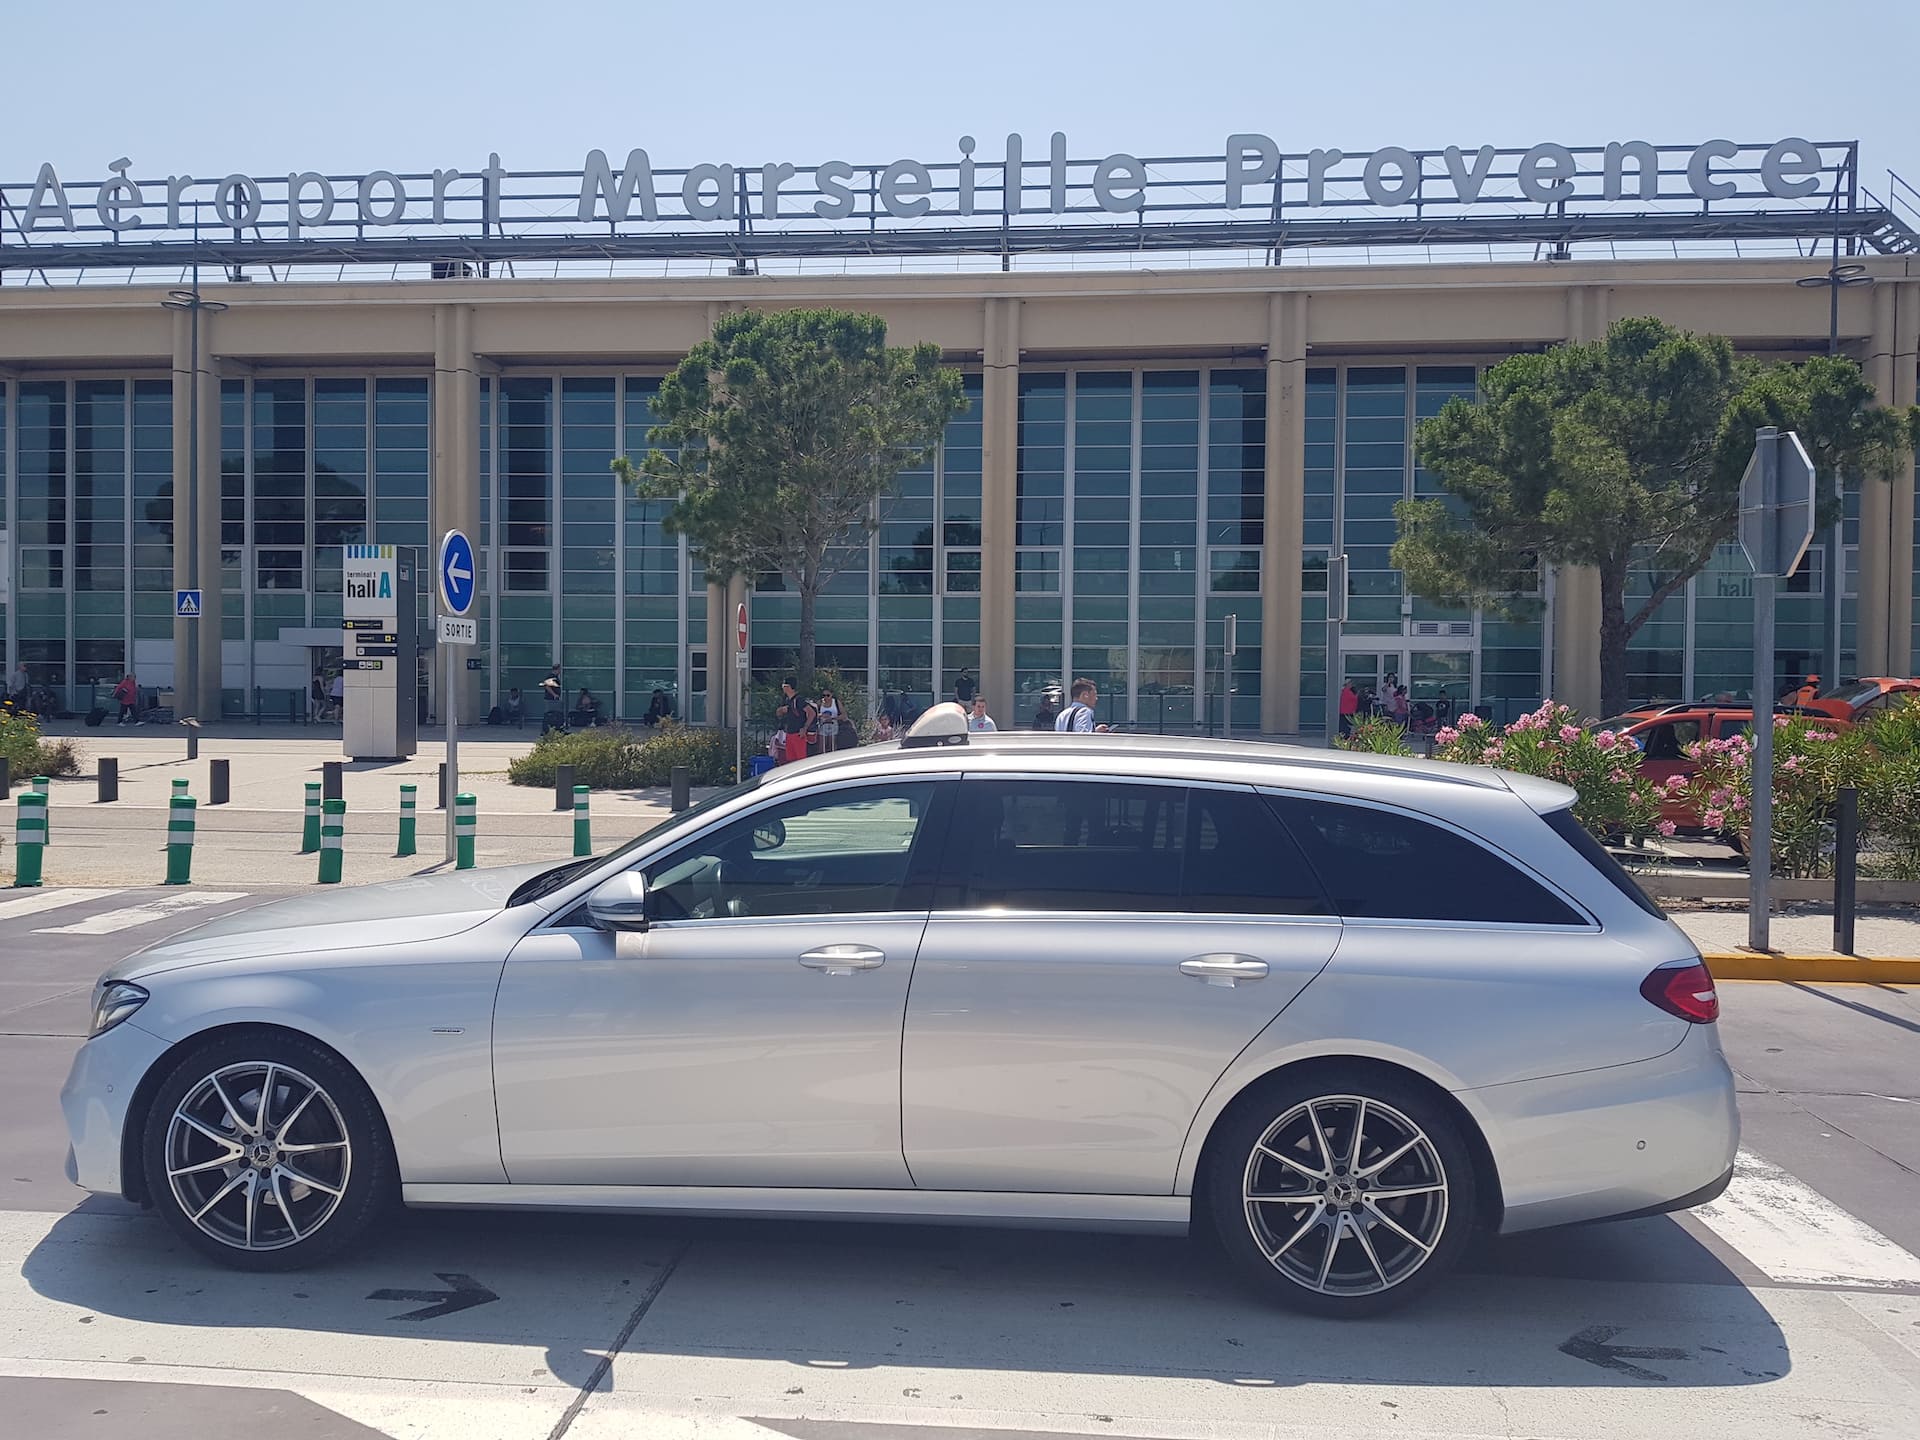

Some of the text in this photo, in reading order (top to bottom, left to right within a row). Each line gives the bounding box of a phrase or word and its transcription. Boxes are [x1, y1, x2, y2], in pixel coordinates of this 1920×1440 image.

[21, 131, 1823, 241] Aéroport Marseille Provence
[347, 579, 376, 598] hall
[379, 571, 392, 598] A
[446, 623, 472, 638] SORTIE
